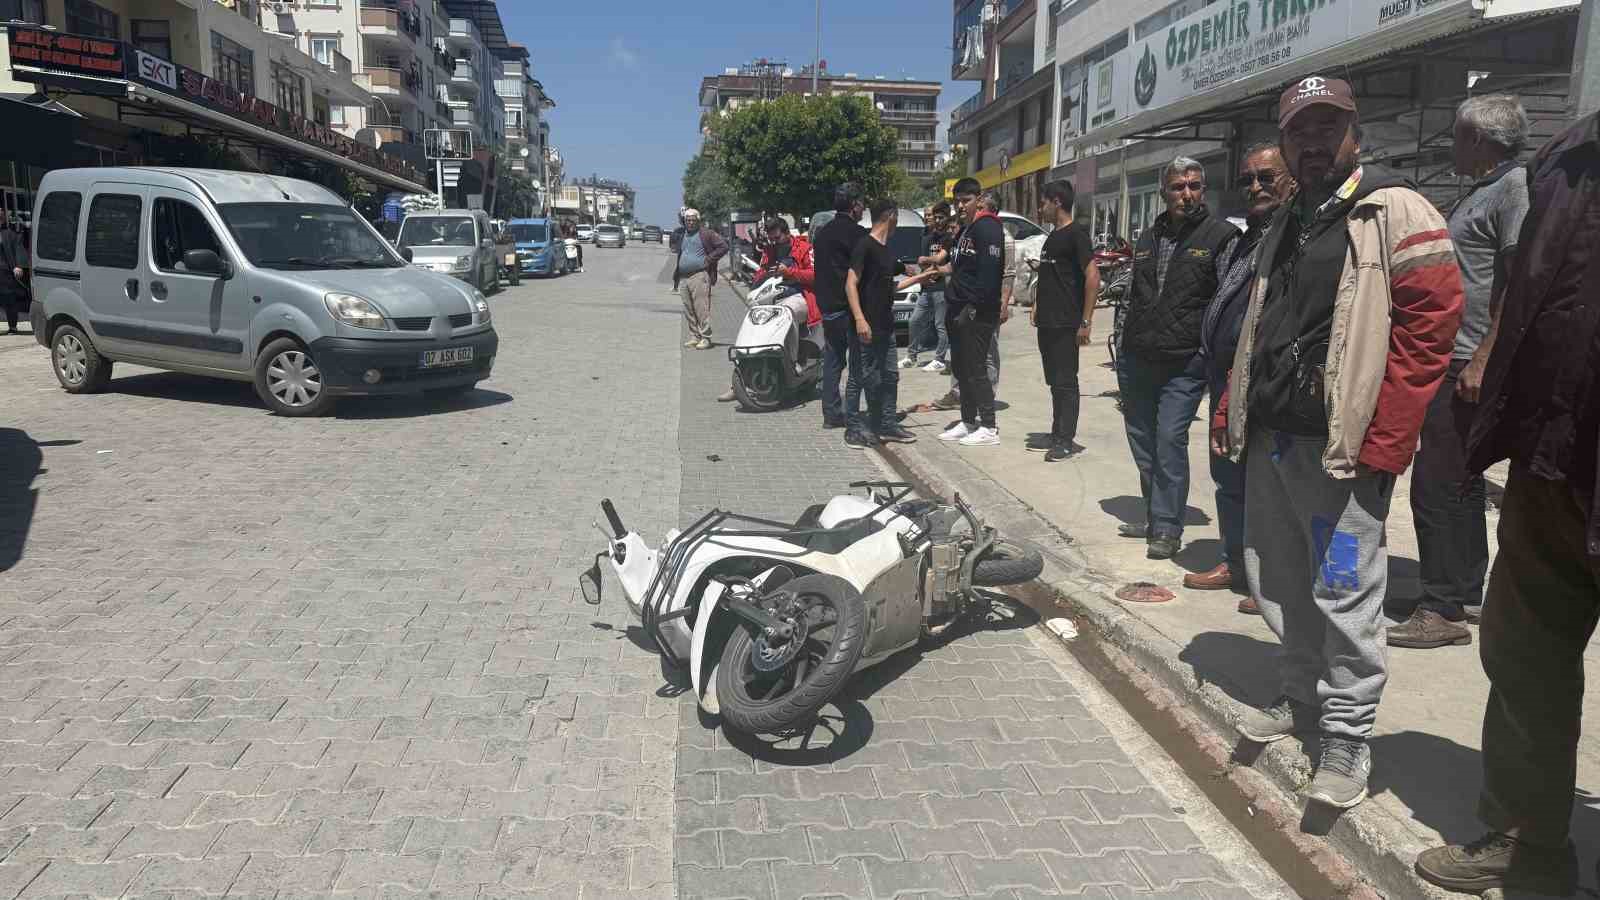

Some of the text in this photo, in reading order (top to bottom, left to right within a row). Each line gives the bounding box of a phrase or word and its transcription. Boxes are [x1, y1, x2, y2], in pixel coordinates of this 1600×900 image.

[1165, 2, 1250, 71] ÖZDEMİR
[141, 54, 173, 85] SKT
[1290, 89, 1336, 104] CHANEL
